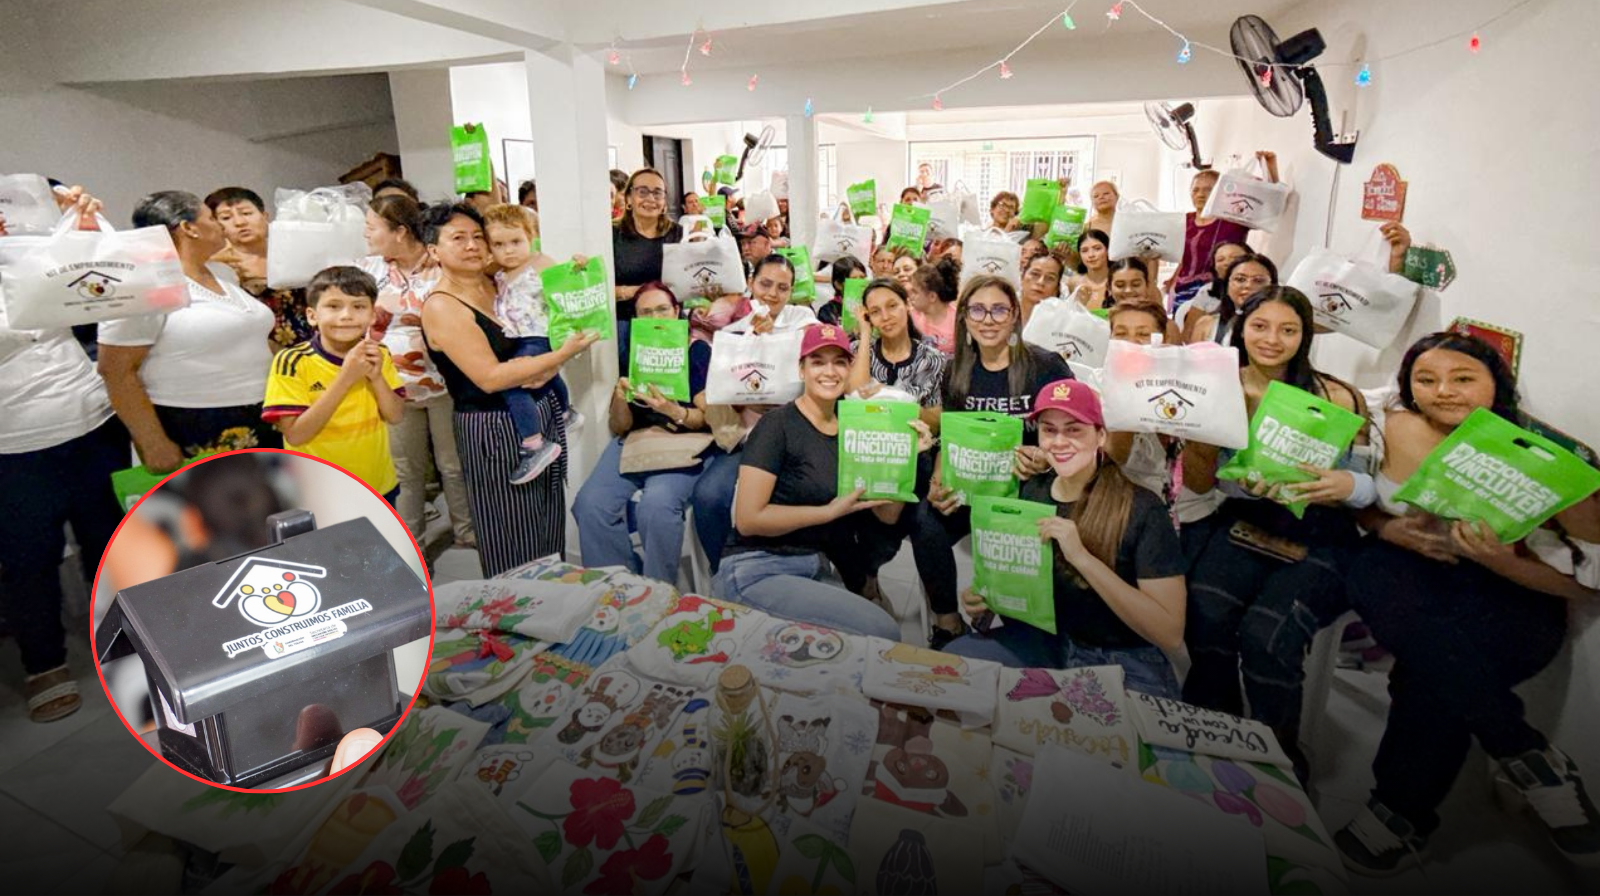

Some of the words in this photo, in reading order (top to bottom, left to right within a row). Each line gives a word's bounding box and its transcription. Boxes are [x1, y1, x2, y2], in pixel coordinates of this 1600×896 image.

[965, 395, 1031, 411] STREET
[858, 430, 905, 443] ACCIONES
[858, 441, 911, 457] INCLUYEN
[1456, 460, 1544, 518] INCLUYEN
[1472, 452, 1551, 500] ACCIONES
[226, 634, 263, 654] JUNTOS
[264, 613, 331, 640] CONSTRUIMOS
[331, 600, 369, 620] FAMILIA
